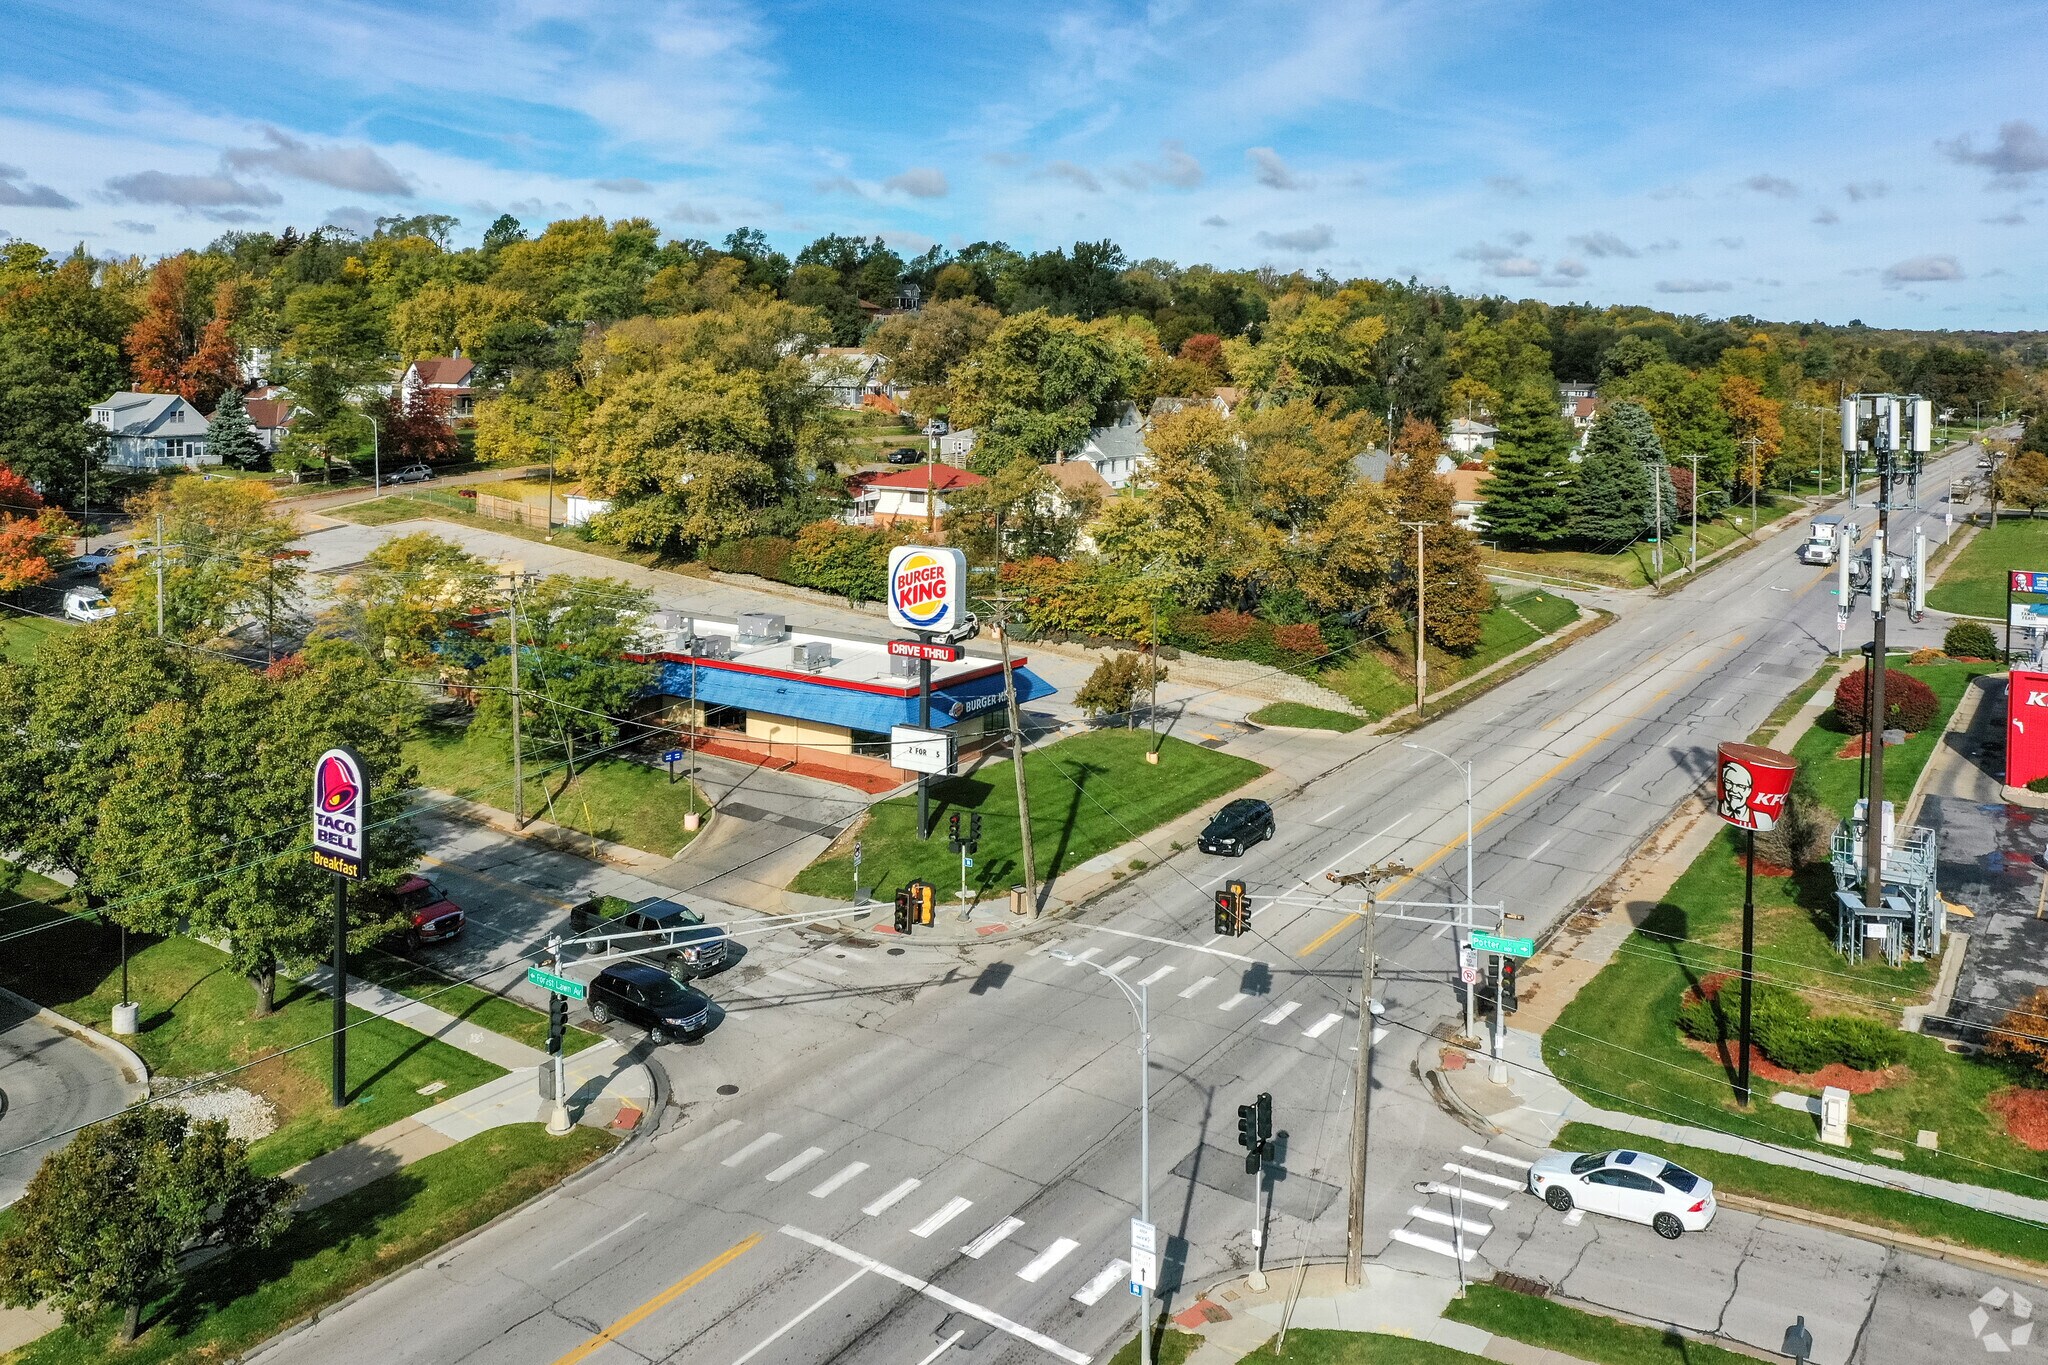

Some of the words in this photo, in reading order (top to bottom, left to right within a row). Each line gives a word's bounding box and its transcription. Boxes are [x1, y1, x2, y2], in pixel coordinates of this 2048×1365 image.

[898, 566, 945, 590] BURGER
[899, 580, 947, 609] KING
[892, 643, 920, 656] DRIVE
[923, 647, 949, 660] THRU
[965, 694, 997, 713] BURGER
[2025, 691, 2048, 707] K
[909, 746, 913, 754] 2
[915, 747, 927, 756] FOR
[315, 812, 357, 835] TACO
[317, 828, 357, 852] BELL
[314, 851, 358, 877] Breakfast
[1473, 937, 1500, 949] Potter
[536, 973, 554, 988] Forest
[555, 980, 572, 993] Lawn
